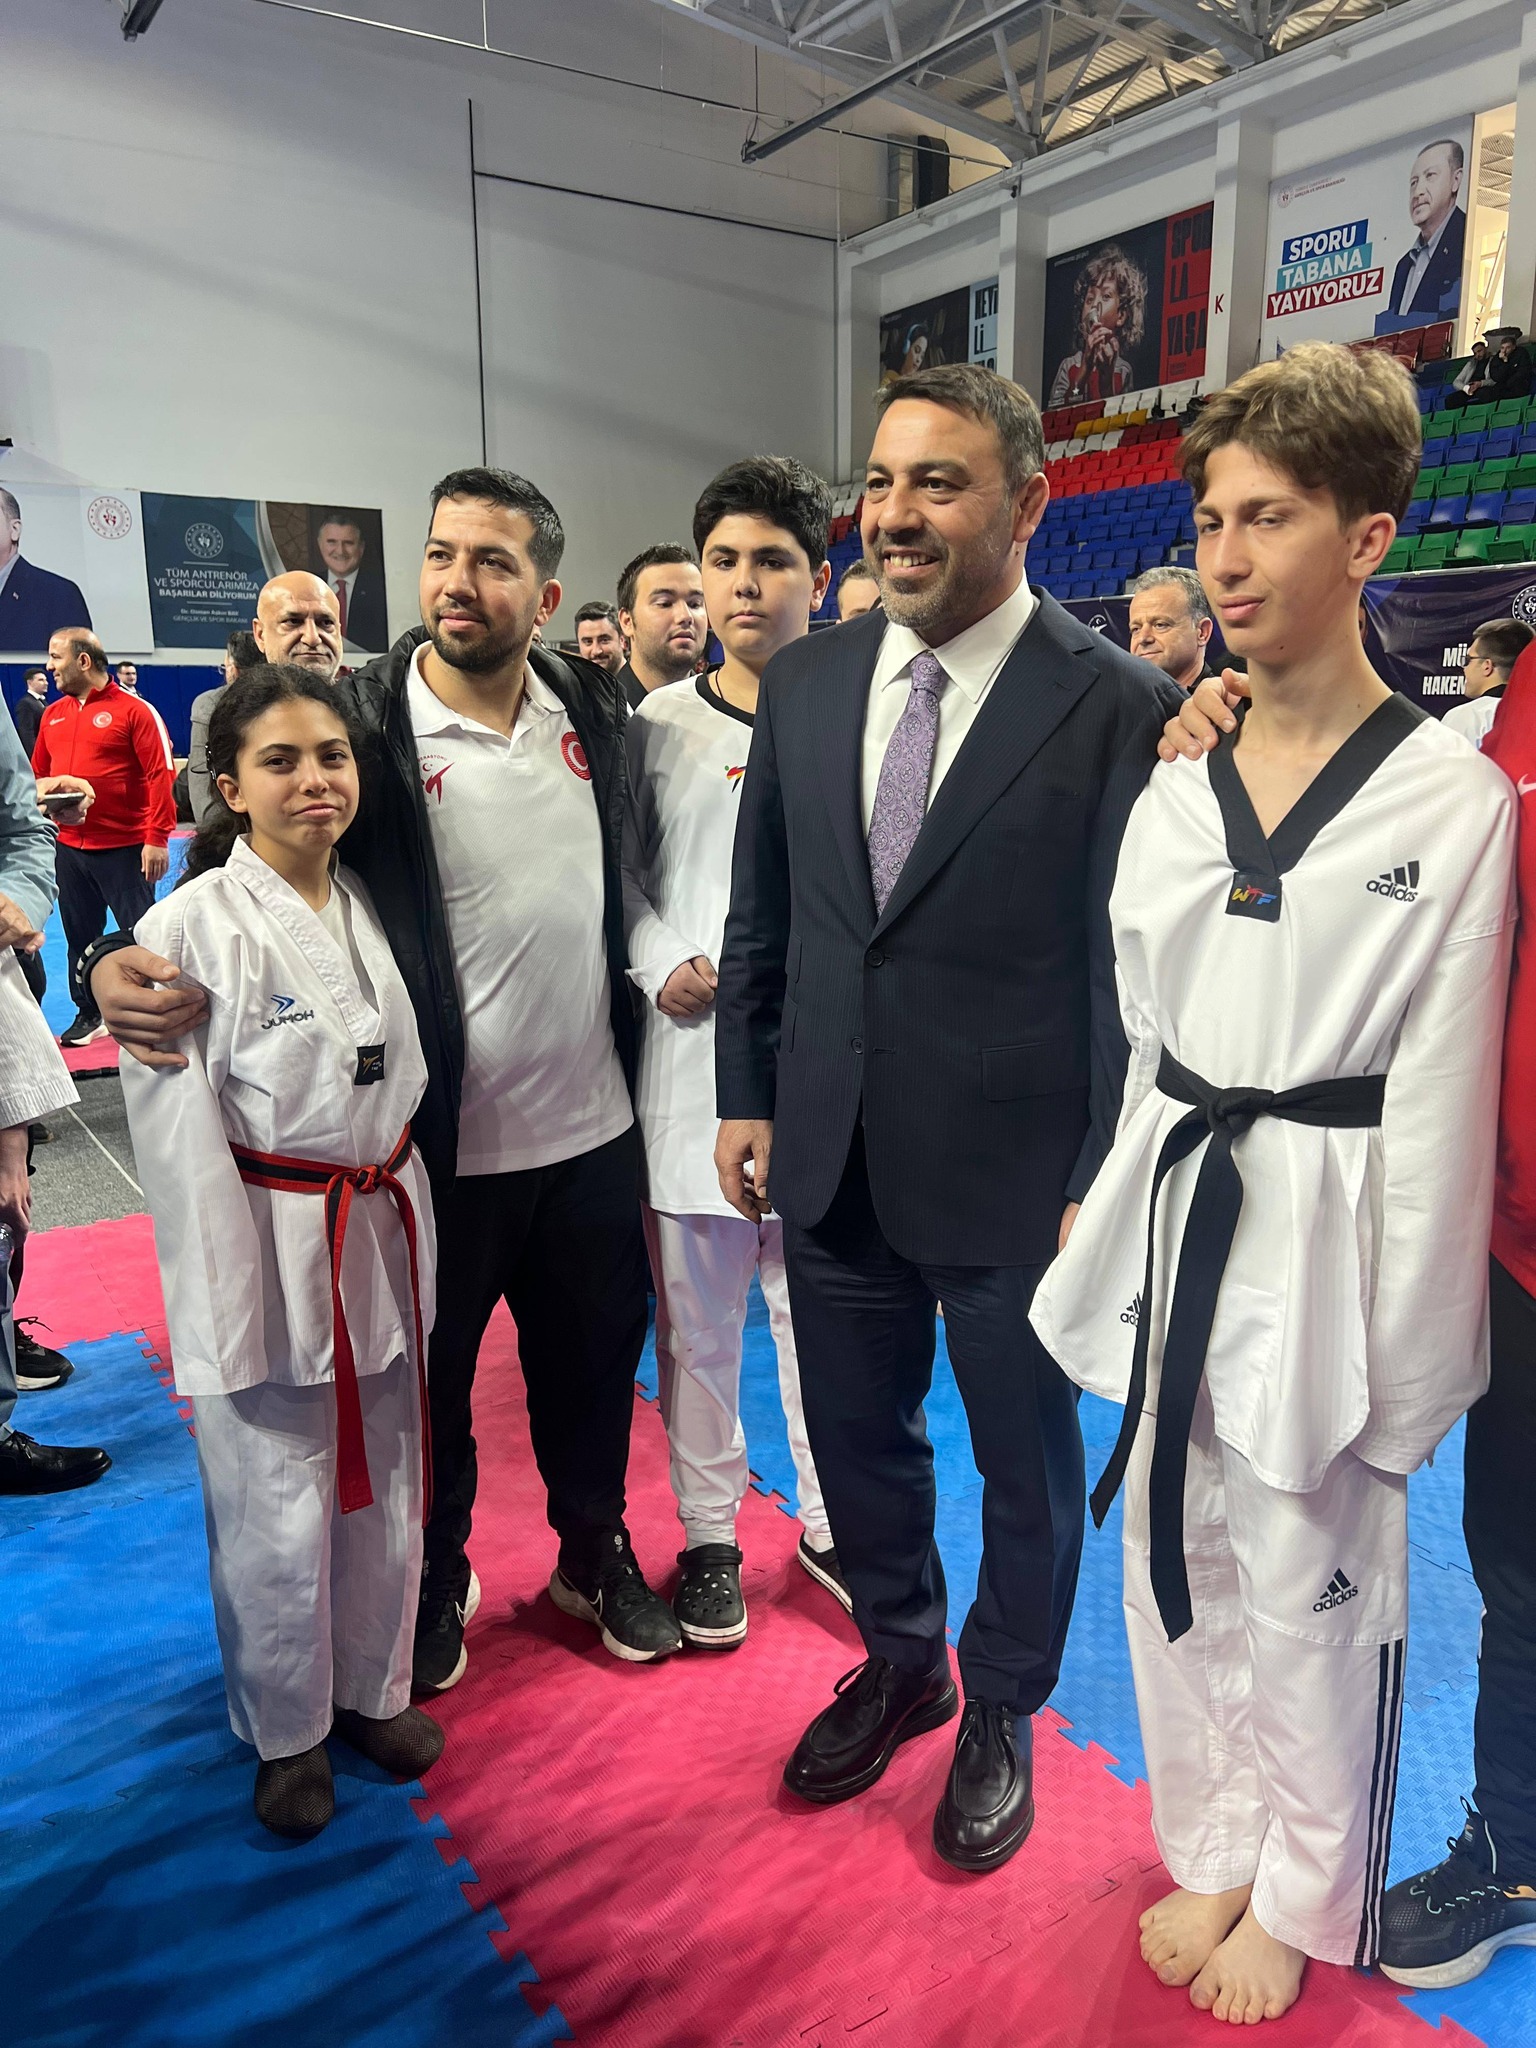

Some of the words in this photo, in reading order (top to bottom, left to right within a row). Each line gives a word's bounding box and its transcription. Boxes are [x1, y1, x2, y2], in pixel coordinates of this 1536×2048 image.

[1289, 225, 1357, 262] SPORU
[1282, 247, 1364, 290] TABANA
[1170, 262, 1189, 303] LA
[1270, 270, 1382, 316] YAYIYORUZ
[1215, 293, 1225, 315] K
[153, 577, 168, 587] VE
[170, 578, 260, 591] SPORCULARIMIZA
[165, 567, 190, 579] TÜM
[192, 569, 248, 581] ANTRENÖR
[159, 589, 208, 598] BAŞARILAR
[1366, 879, 1419, 903] adidas
[1312, 1585, 1359, 1613] adidas
